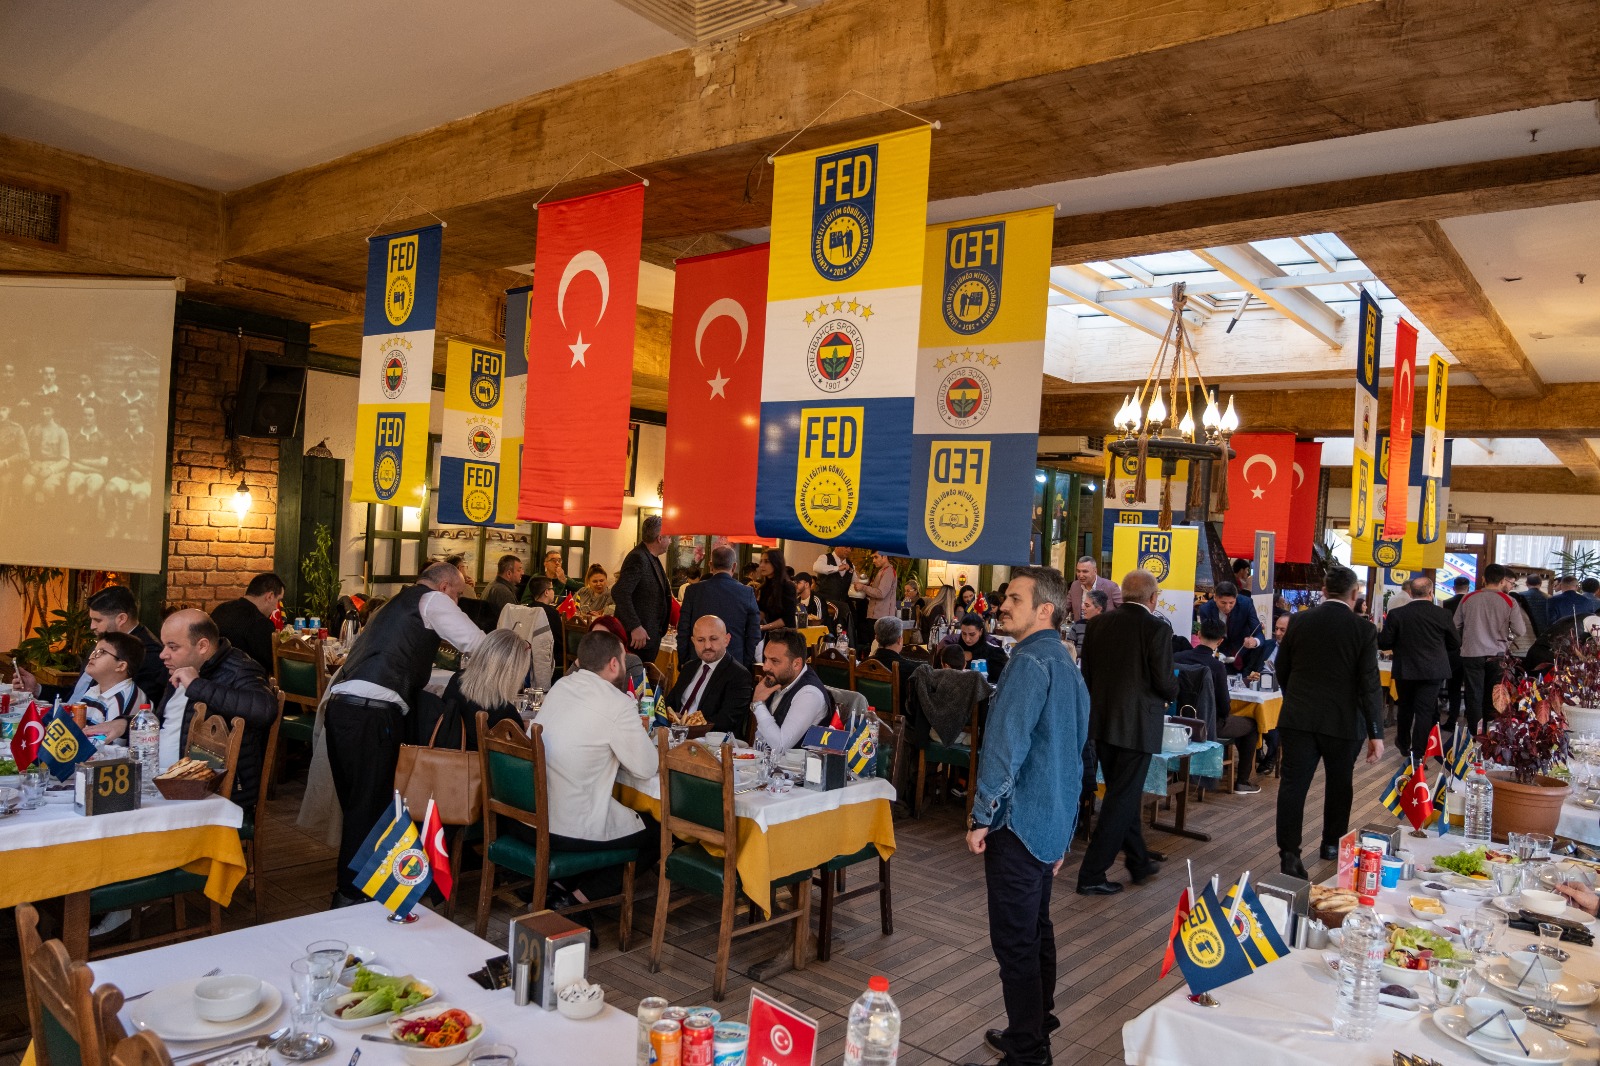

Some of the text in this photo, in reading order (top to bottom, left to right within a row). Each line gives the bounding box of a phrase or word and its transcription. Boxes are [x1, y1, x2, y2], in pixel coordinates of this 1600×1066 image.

[819, 154, 872, 205] FED
[390, 241, 415, 273] FED
[852, 238, 868, 269] DERNEĞİ
[833, 267, 847, 276] 2024
[474, 352, 500, 375] FED
[808, 321, 834, 379] FENERBAHÇE
[836, 321, 857, 337] SPOR
[825, 381, 841, 390] 1907
[378, 418, 403, 447] FED
[805, 416, 857, 458] FED
[467, 467, 493, 488] FED
[1141, 534, 1169, 553] FED
[42, 722, 66, 747] FED
[820, 731, 832, 746] K
[98, 764, 130, 797] 58
[1182, 902, 1208, 932] FED
